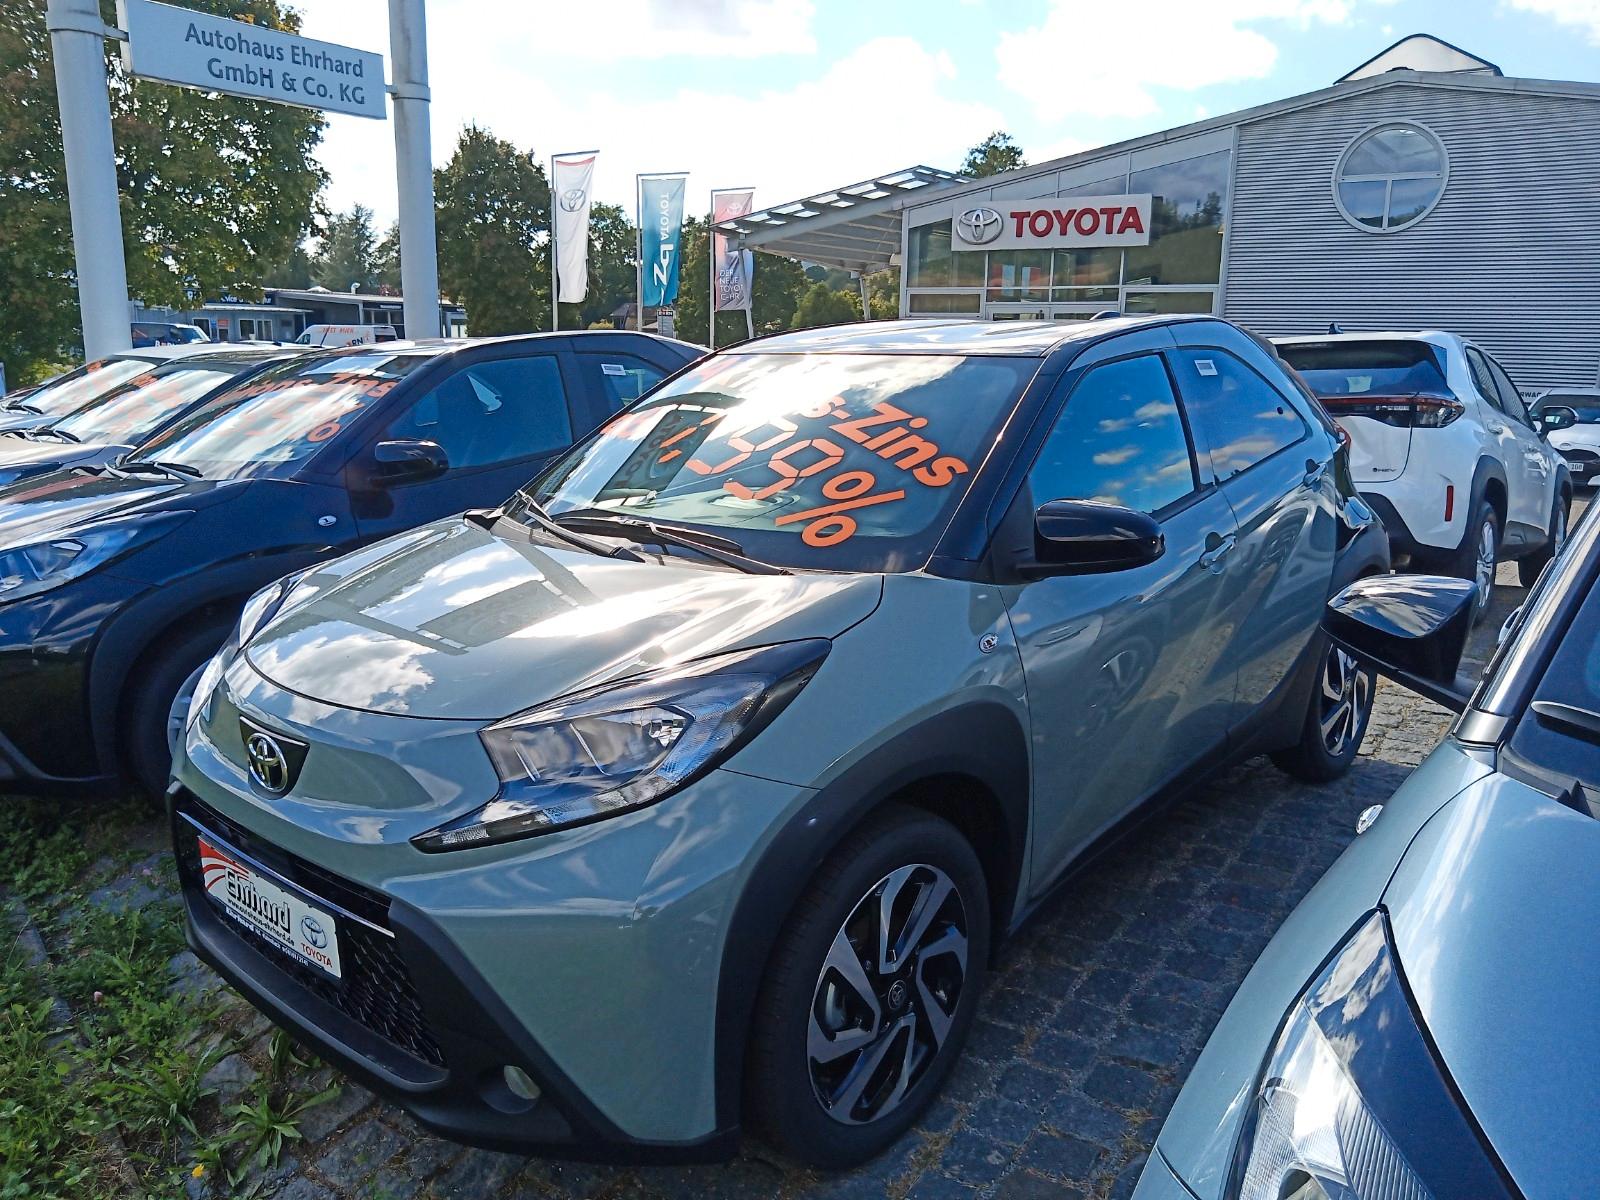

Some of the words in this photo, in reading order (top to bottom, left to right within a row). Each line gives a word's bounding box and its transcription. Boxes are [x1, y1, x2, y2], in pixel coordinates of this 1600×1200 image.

[185, 23, 285, 61] Autohaus
[290, 45, 364, 78] Ehrhard
[207, 58, 275, 89] GmbH
[281, 72, 297, 93] &
[303, 76, 334, 100] Co.
[339, 83, 365, 105] KG
[660, 192, 670, 241] TOYOTA
[1010, 206, 1144, 238] TOYOTA
[719, 269, 734, 277] DER
[720, 277, 739, 285] NEUE
[720, 285, 744, 293] TOYOT
[720, 293, 740, 301] C-HR
[225, 867, 291, 934] Ehrhard
[301, 942, 333, 969] TOYOTA
